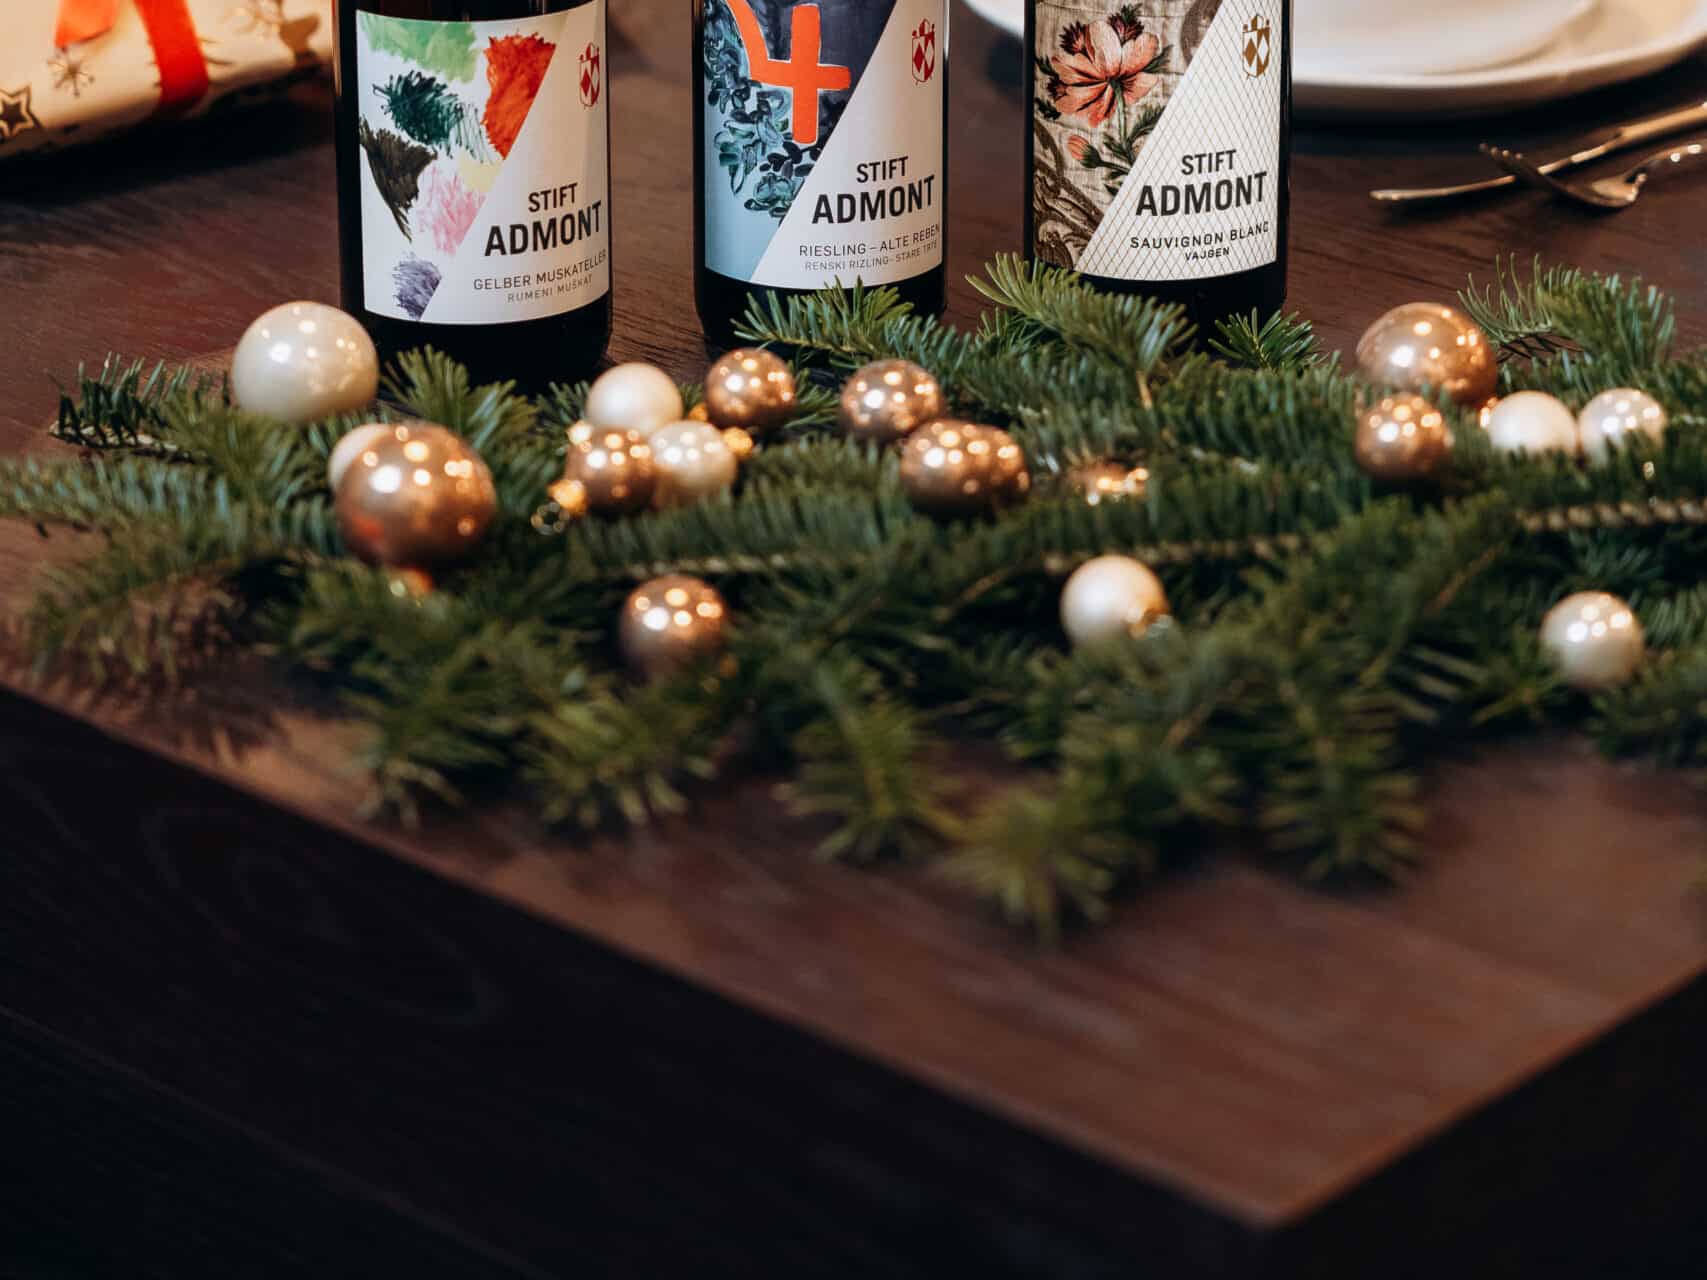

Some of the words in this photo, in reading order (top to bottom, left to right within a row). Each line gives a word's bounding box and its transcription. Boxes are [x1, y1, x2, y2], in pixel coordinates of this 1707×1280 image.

[857, 156, 909, 183] STIFT
[1181, 149, 1237, 175] STIFT
[528, 182, 578, 212] STIFT
[812, 174, 935, 224] ADMONT
[1136, 171, 1267, 217] ADMONT
[484, 200, 601, 257] ADMONT
[1130, 233, 1223, 249] SAUVIGNON
[1230, 221, 1269, 241] BLANC
[799, 243, 866, 257] RIESLING
[880, 235, 909, 252] ALTE
[1185, 247, 1230, 261] VAJGEN
[473, 275, 531, 291] GELBER
[536, 248, 607, 283] MUSKATELLER
[805, 261, 846, 271] RENSKI
[849, 255, 889, 269] RIZLING
[507, 288, 553, 303] RUMENI
